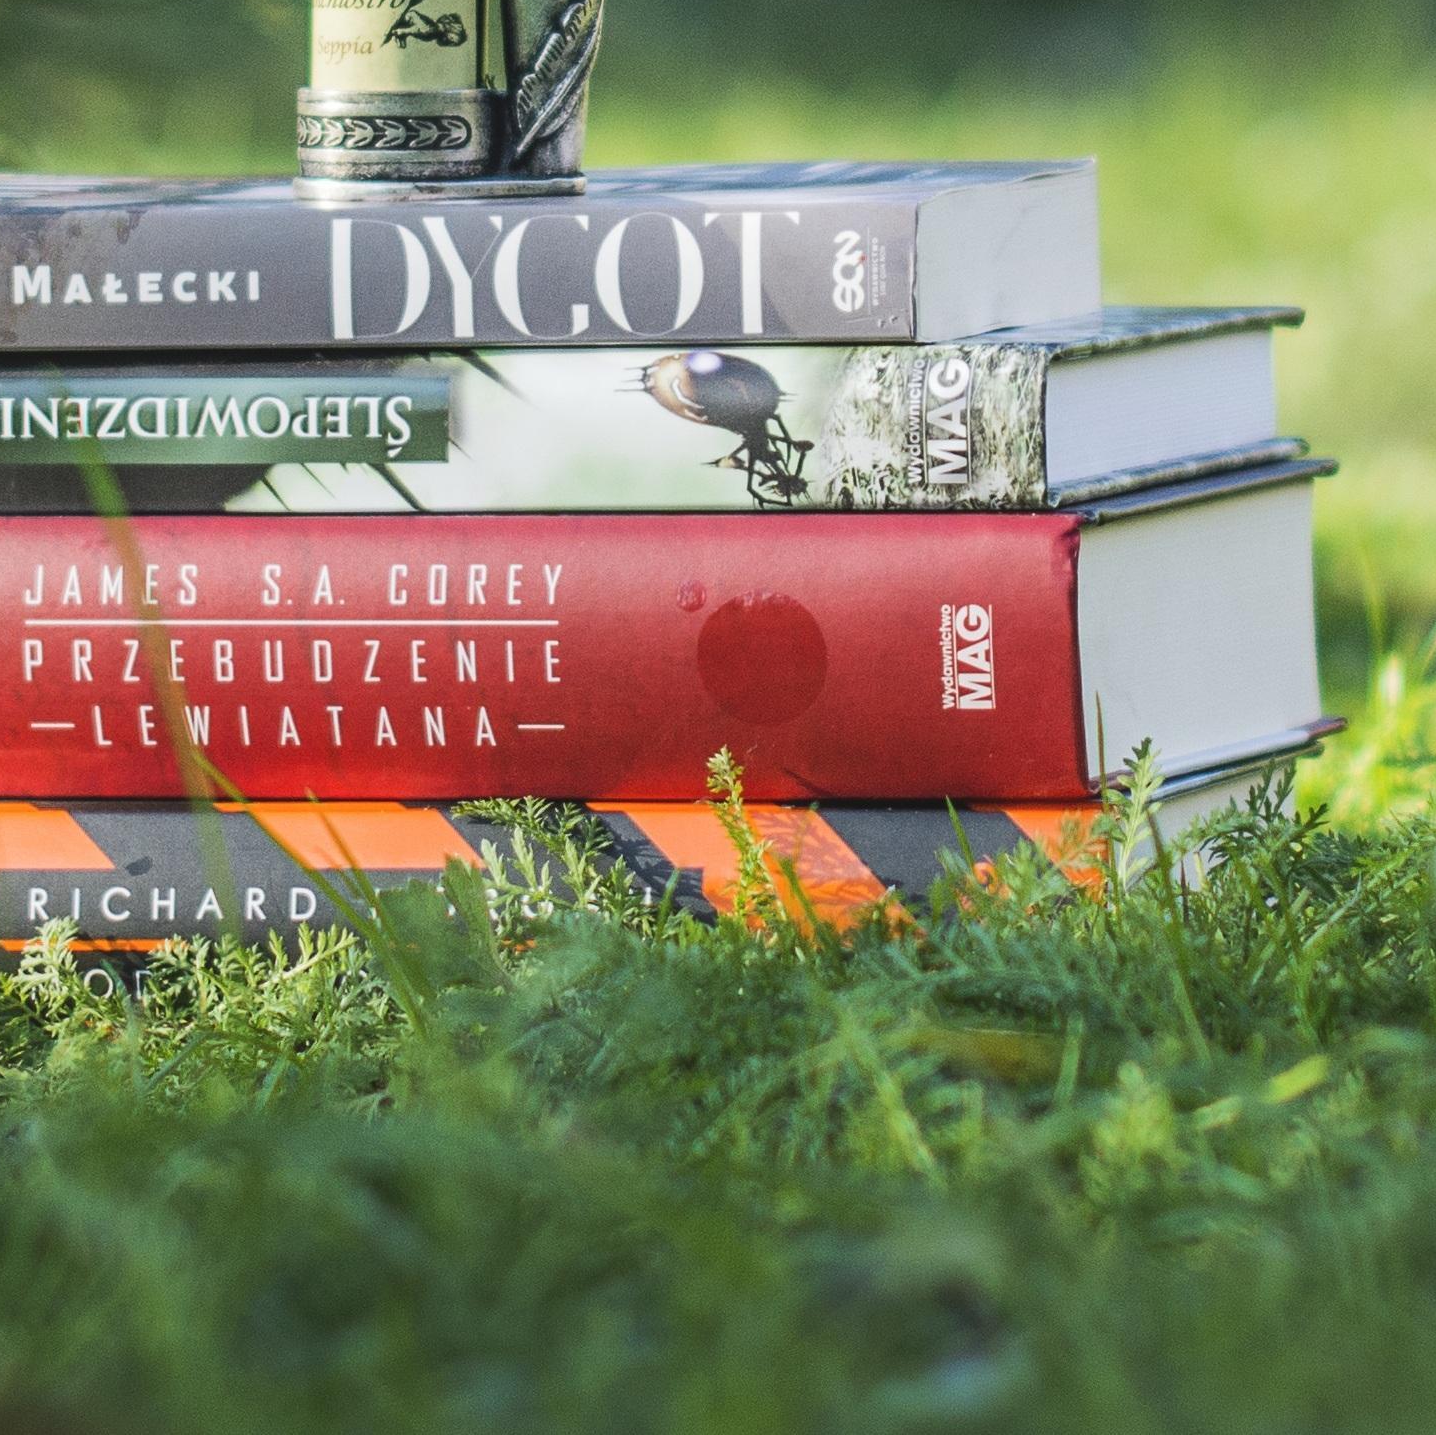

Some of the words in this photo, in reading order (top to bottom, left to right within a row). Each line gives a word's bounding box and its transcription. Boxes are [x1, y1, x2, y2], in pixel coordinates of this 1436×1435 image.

[13, 264, 262, 306] MAŁECKI
[331, 211, 801, 340] DYGOT
[908, 358, 926, 484] Wydawnictwo
[927, 358, 970, 484] MAG
[23, 563, 198, 606] JAMES
[262, 564, 346, 606] S.A.
[389, 563, 564, 606] COREY
[22, 639, 562, 682] PRZEBUDZENIE
[939, 604, 956, 709] Wydawnictwo
[955, 603, 993, 709] MAG
[91, 704, 498, 747] LEWIATANA
[28, 886, 319, 922] RICHARD
